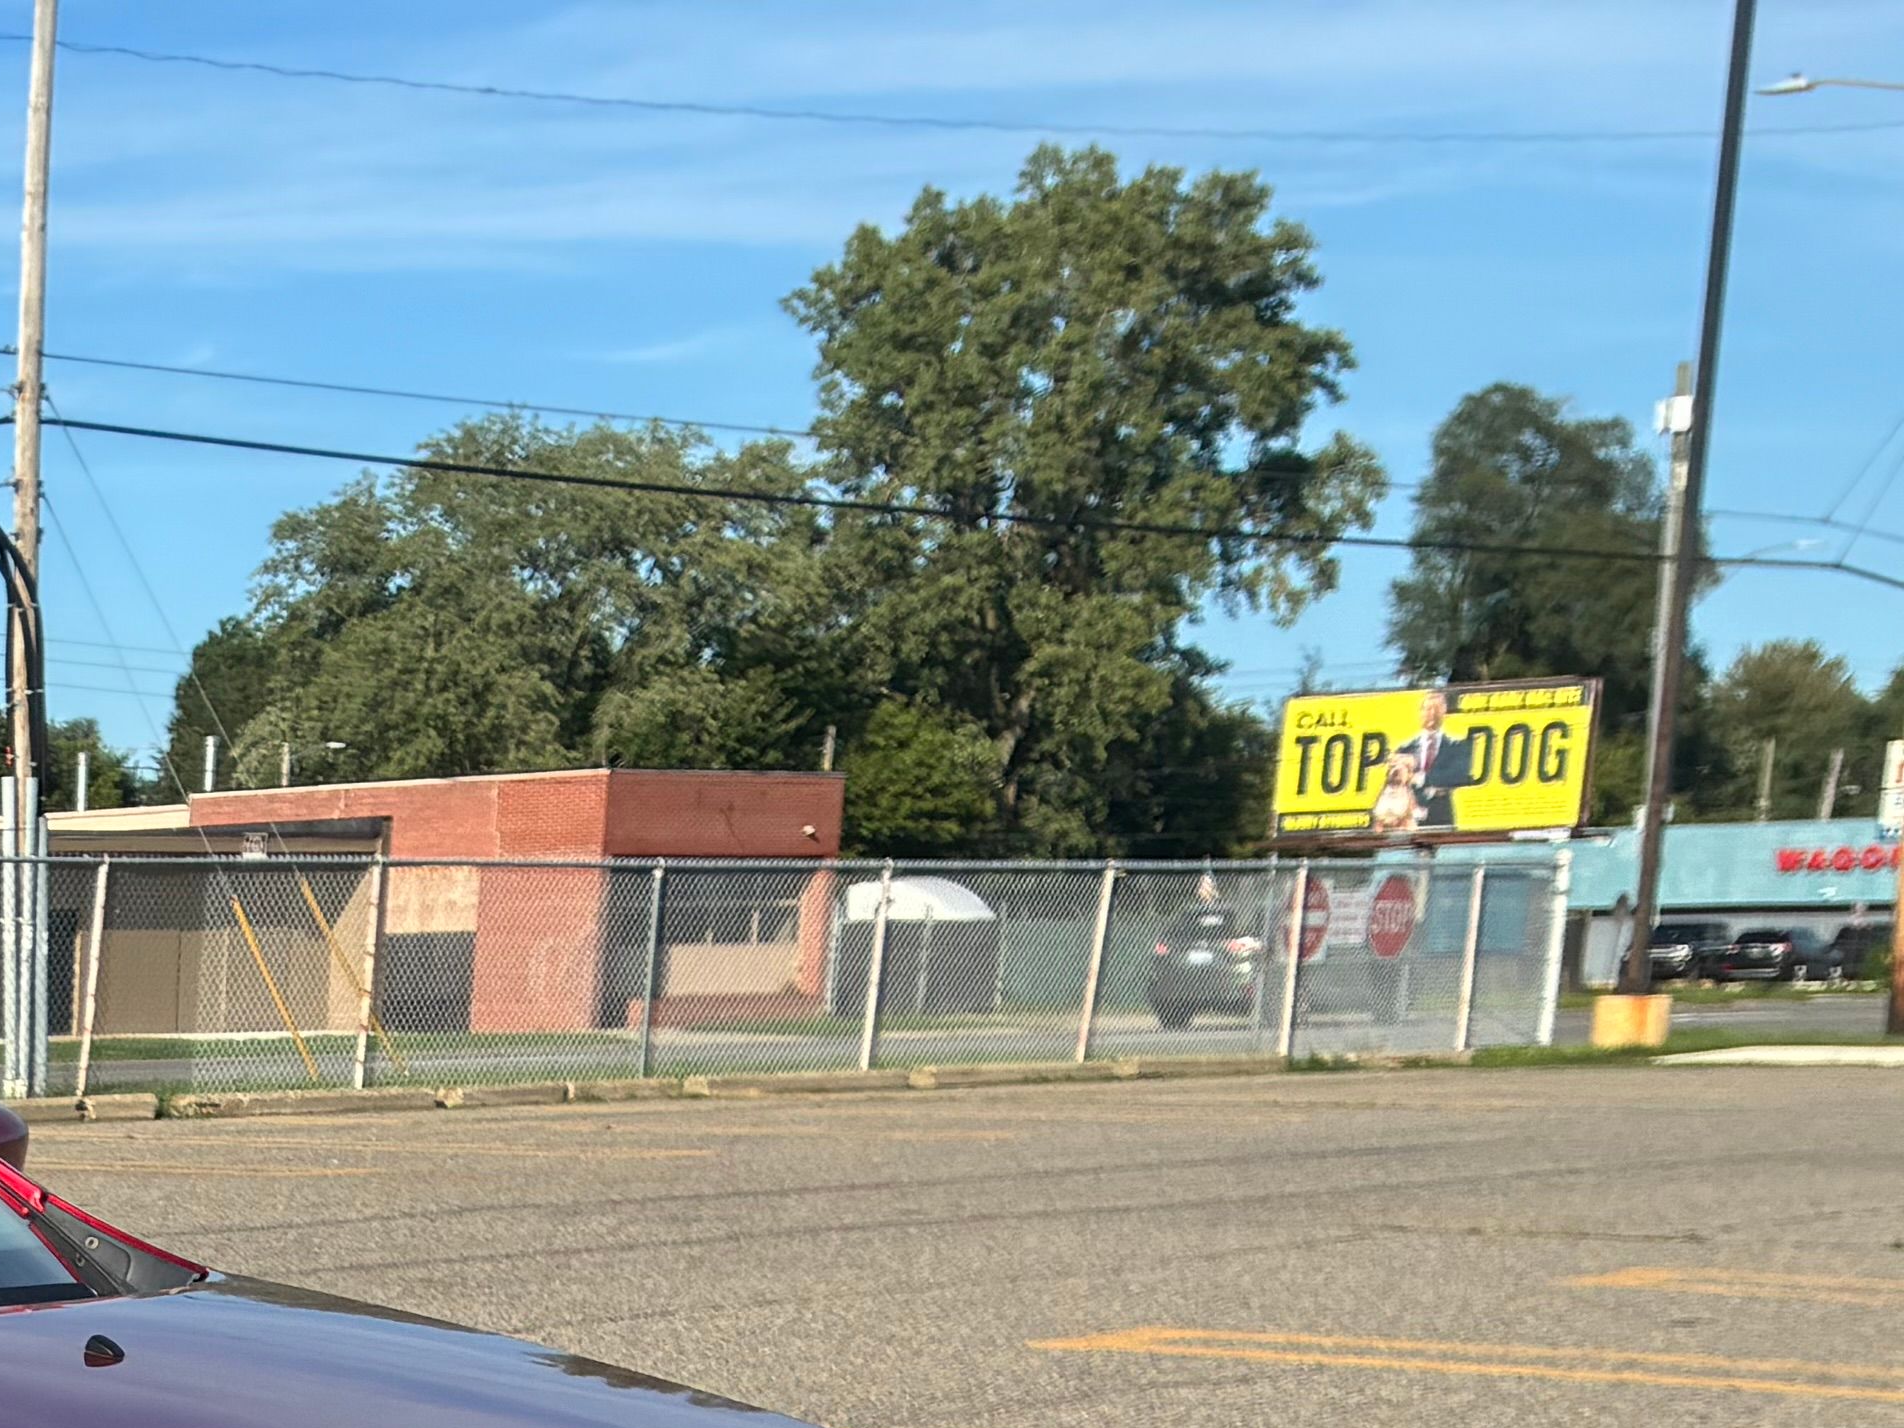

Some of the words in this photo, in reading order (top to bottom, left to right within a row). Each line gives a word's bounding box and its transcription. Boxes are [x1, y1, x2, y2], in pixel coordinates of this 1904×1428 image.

[1295, 709, 1351, 729] CALL
[1294, 731, 1389, 796] TOP
[1466, 720, 1570, 789] DOG
[1371, 899, 1413, 934] STOP
